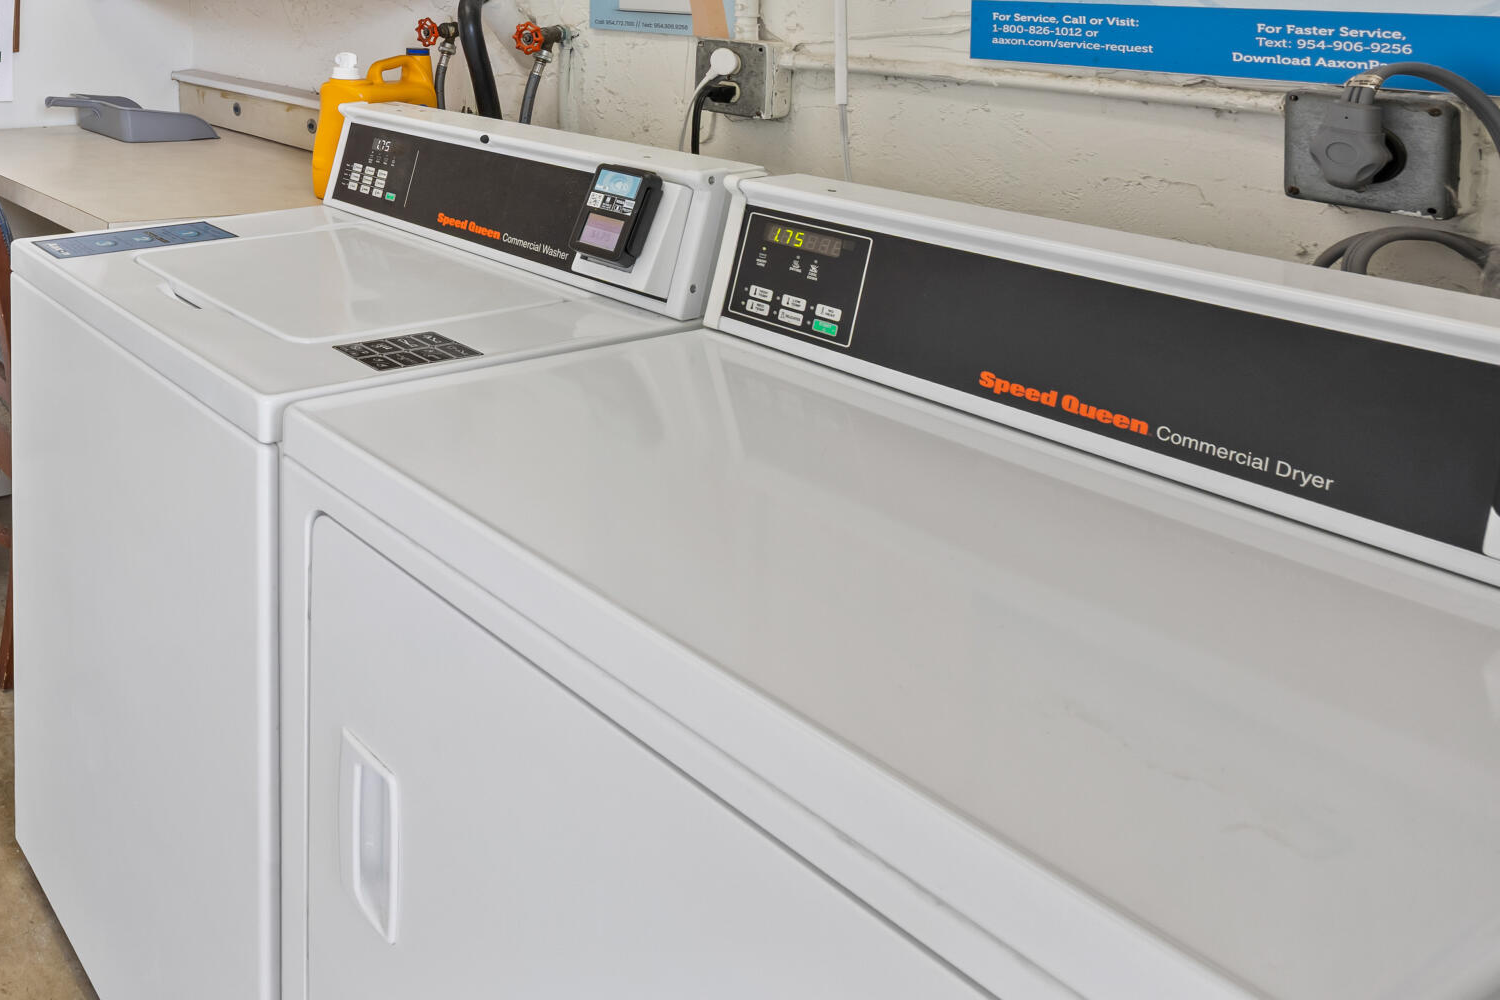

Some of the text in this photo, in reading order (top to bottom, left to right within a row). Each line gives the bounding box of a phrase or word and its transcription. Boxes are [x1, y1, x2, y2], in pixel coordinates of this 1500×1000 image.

[992, 12, 1010, 21] For
[1014, 13, 1059, 24] Service,
[1062, 15, 1087, 25] Call
[1106, 16, 1140, 27] Visit:
[992, 25, 1082, 37] 1-800-826-1012
[1257, 23, 1406, 41] For Faster Service,
[992, 37, 1154, 54] aaxon.com/service-request
[1255, 36, 1412, 54] Text: 954-906-9256
[1232, 52, 1311, 66] Download
[437, 212, 569, 260] Speed Queen Commercial Washer
[774, 228, 804, 247] 1.75
[979, 370, 1334, 491] Speed Queen Commercial Dryer
